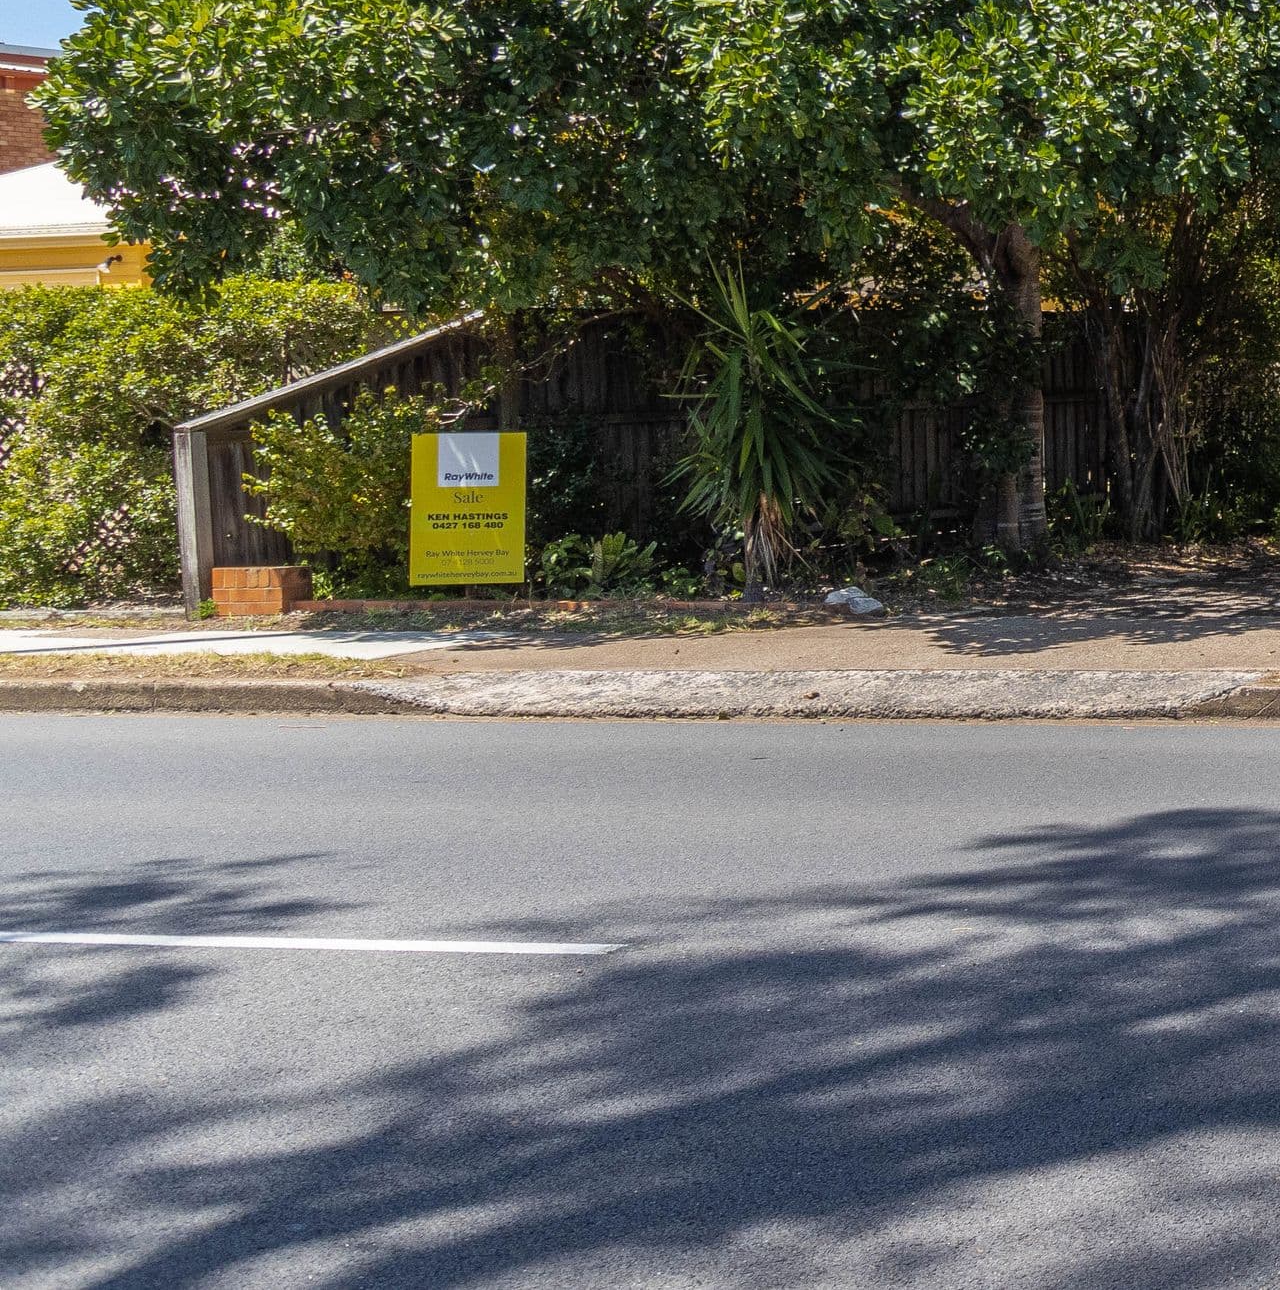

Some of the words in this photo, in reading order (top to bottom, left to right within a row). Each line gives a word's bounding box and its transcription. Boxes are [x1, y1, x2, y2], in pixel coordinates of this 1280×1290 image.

[444, 472, 494, 482] RayWhite
[454, 490, 484, 503] Sale
[427, 513, 450, 521] KEN
[453, 513, 508, 521] HASTINGS
[484, 521, 504, 529] 480
[425, 550, 440, 558] Ray
[467, 549, 493, 557] Hervey
